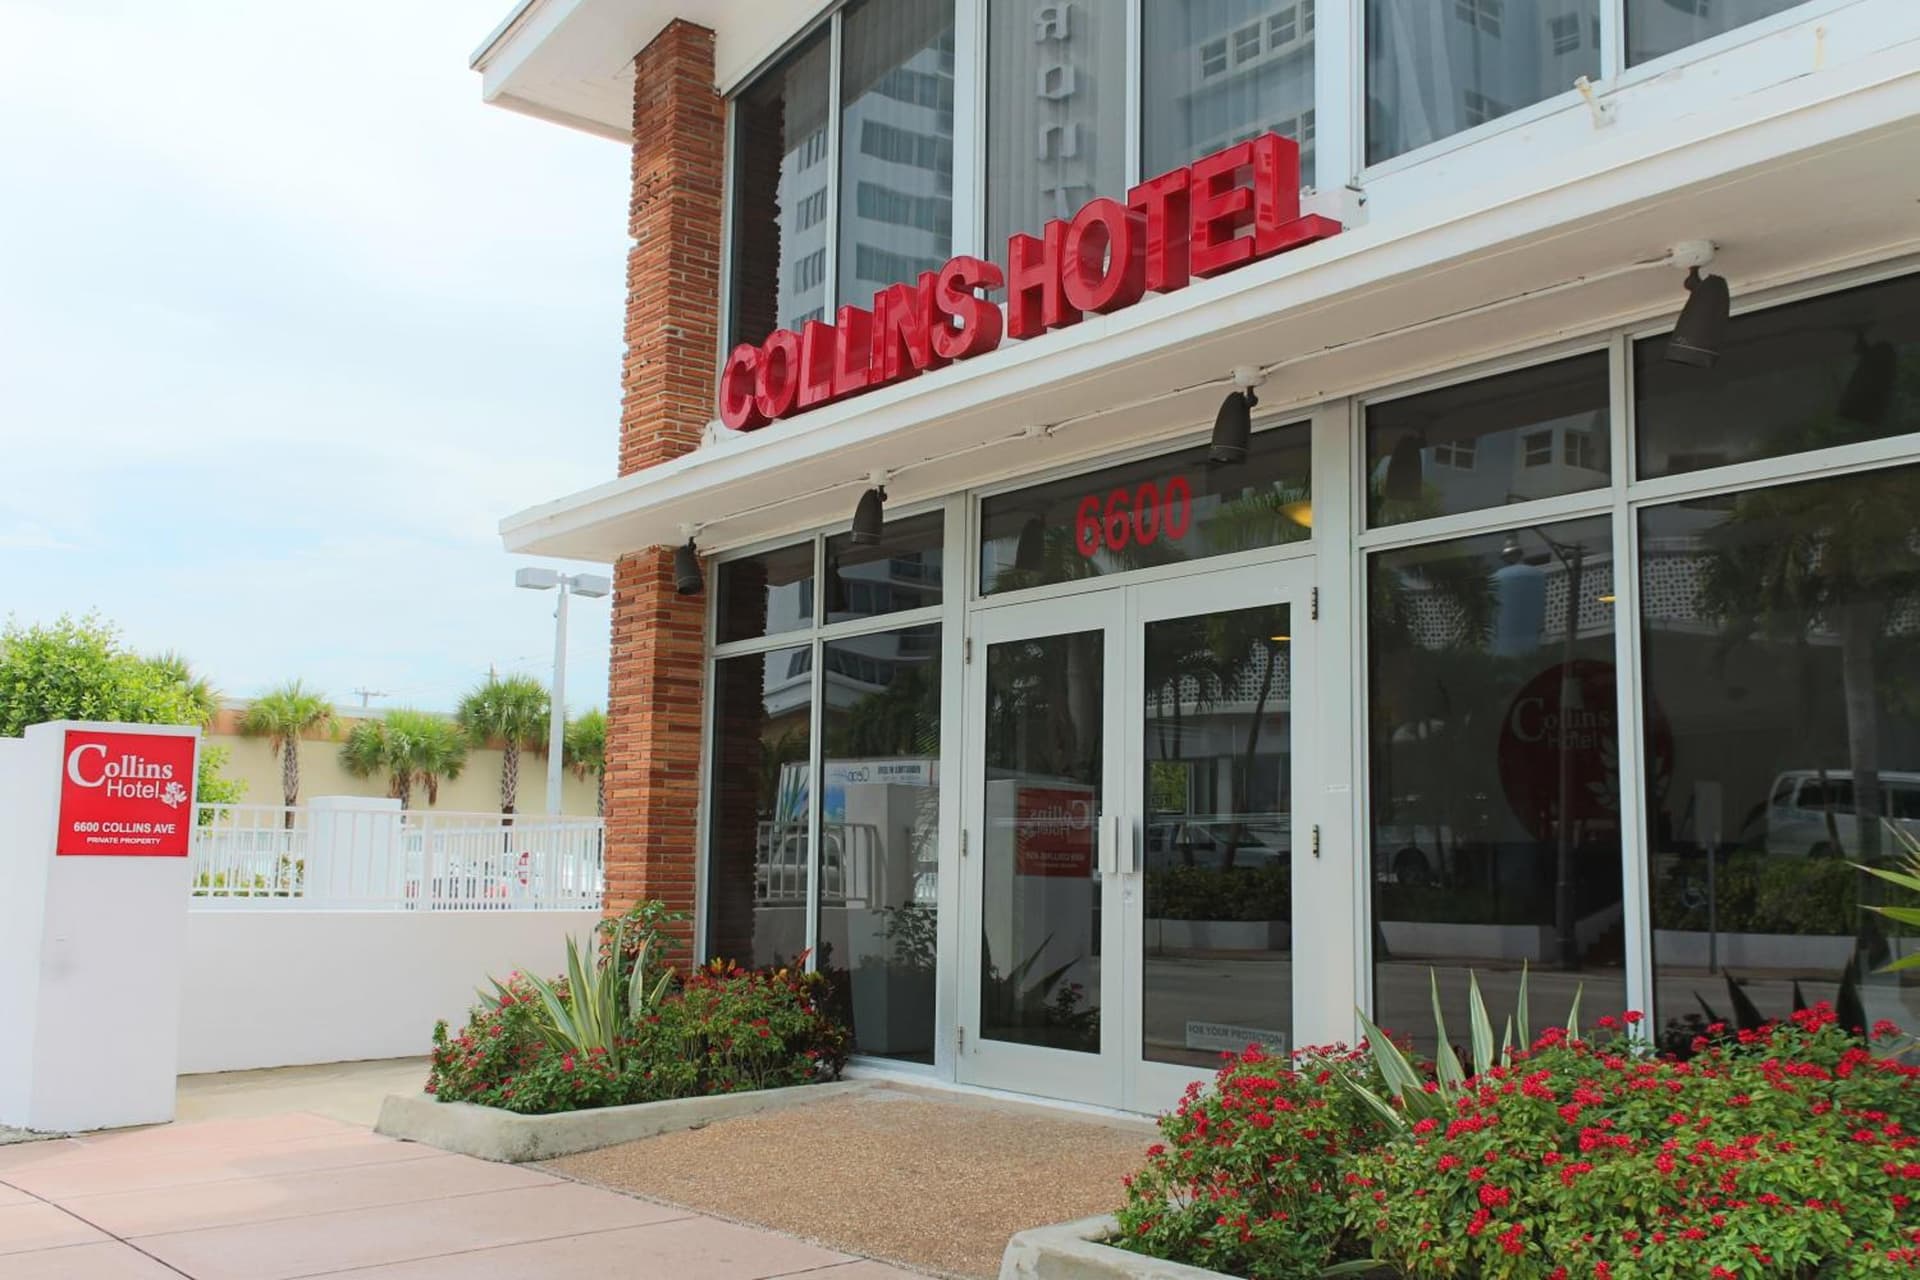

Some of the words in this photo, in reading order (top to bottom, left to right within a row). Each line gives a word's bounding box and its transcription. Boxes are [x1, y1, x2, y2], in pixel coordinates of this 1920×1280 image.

[719, 255, 1004, 431] COLLINS
[1007, 131, 1341, 340] HOTEL
[1075, 475, 1192, 557] 6600
[67, 744, 173, 788] Collins
[107, 778, 159, 798] Hotel
[73, 821, 99, 833] 6600
[102, 822, 152, 834] COLLINS
[153, 823, 176, 834] AVE
[87, 836, 119, 845] PRIVATE
[120, 837, 161, 845] PROPERTY
